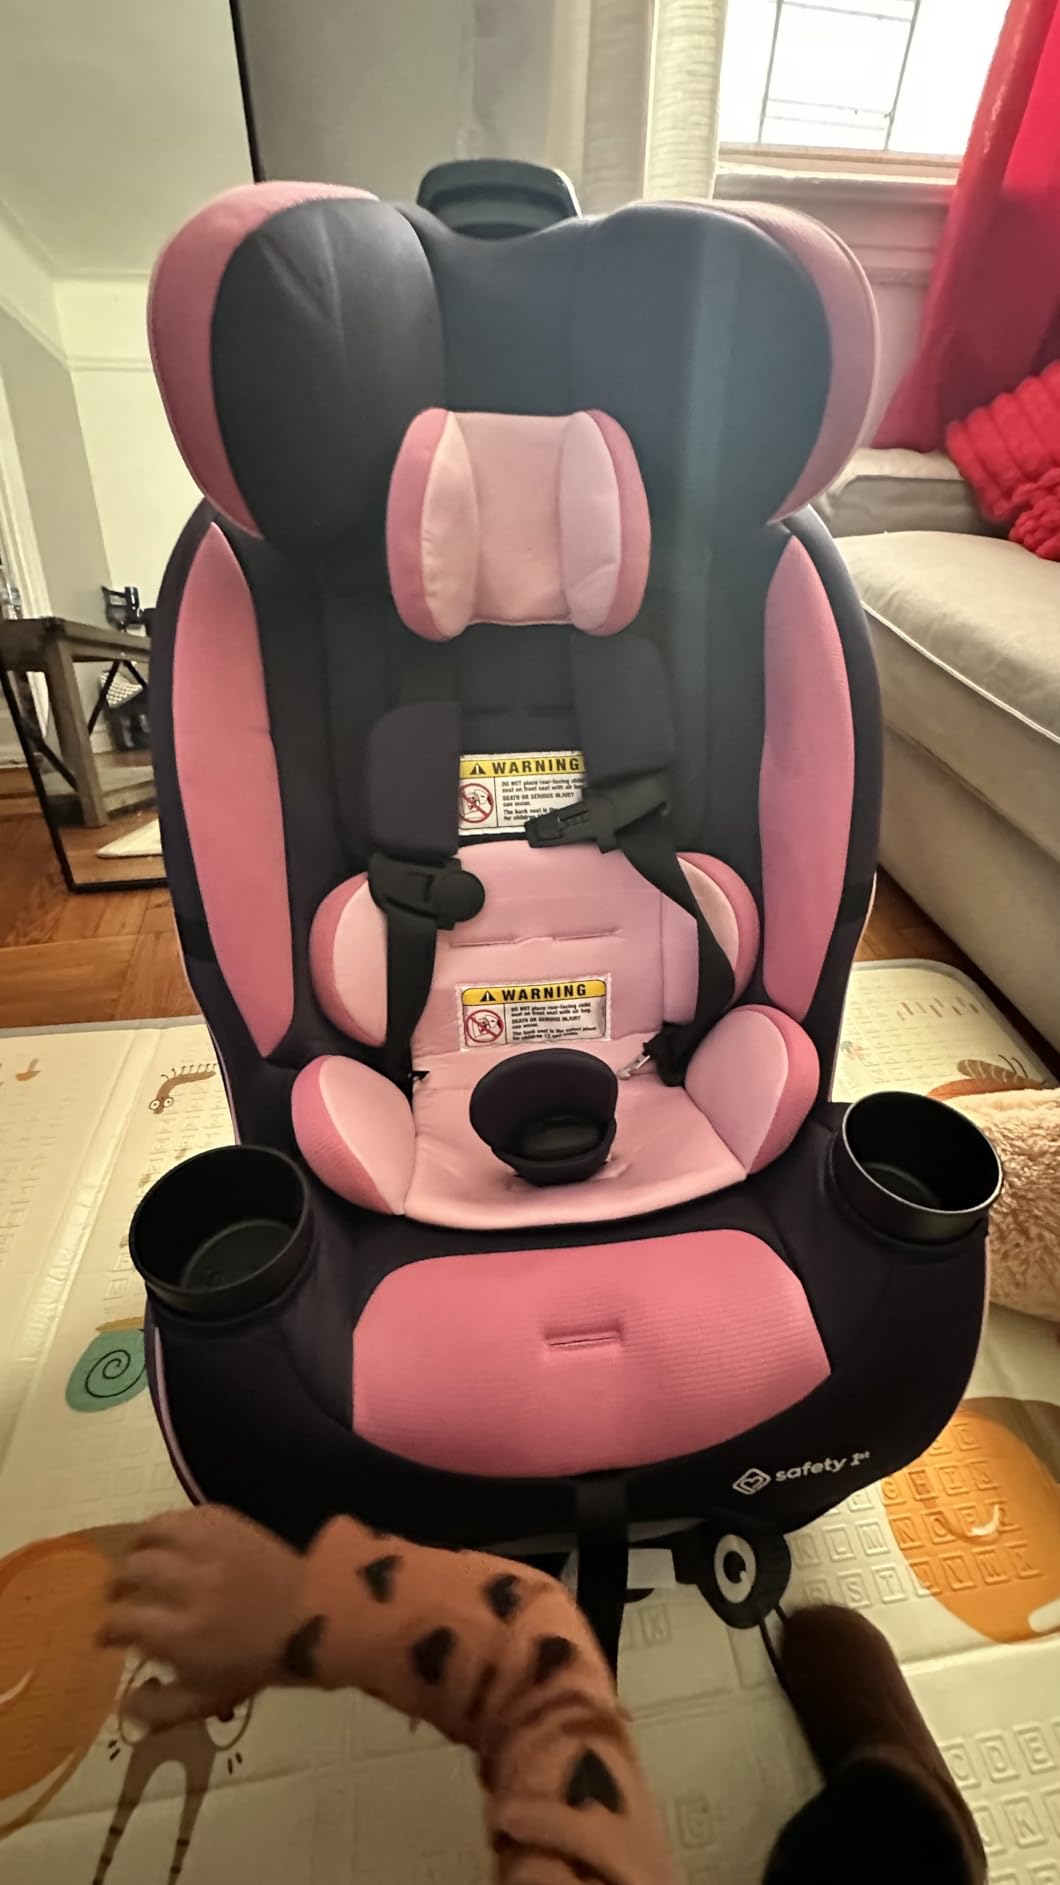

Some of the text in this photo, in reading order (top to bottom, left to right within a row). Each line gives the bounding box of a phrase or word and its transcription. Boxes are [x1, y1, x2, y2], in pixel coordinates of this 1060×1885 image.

[492, 758, 579, 774] WARNING
[501, 984, 586, 1002] WARNING
[774, 1457, 848, 1482] safety
